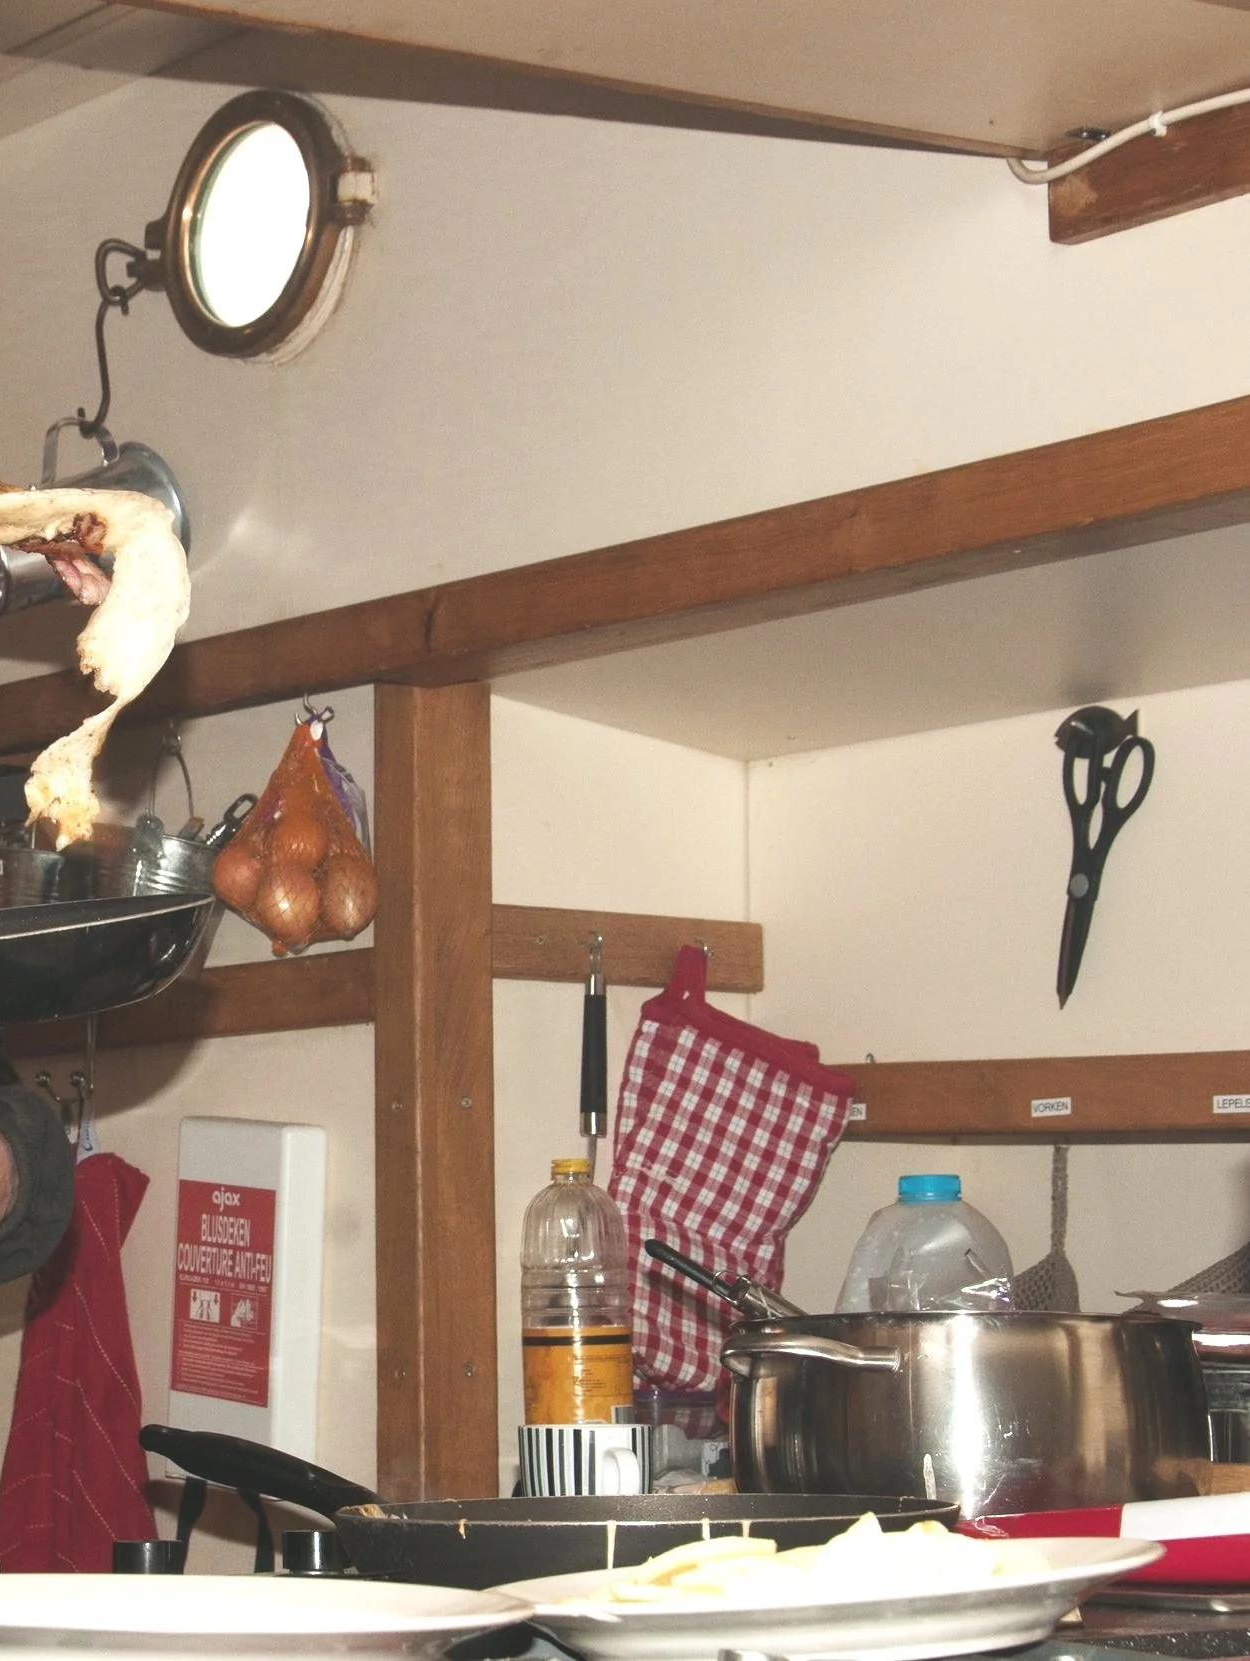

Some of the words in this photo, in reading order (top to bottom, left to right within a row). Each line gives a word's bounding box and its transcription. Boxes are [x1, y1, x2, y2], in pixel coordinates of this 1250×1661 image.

[1033, 1101, 1069, 1113] VORKEN
[212, 1186, 240, 1212] ajax
[201, 1213, 250, 1247] BLUSDEKEN
[177, 1242, 233, 1277] COUVERTURE
[234, 1250, 272, 1283] ANTI-FEU
